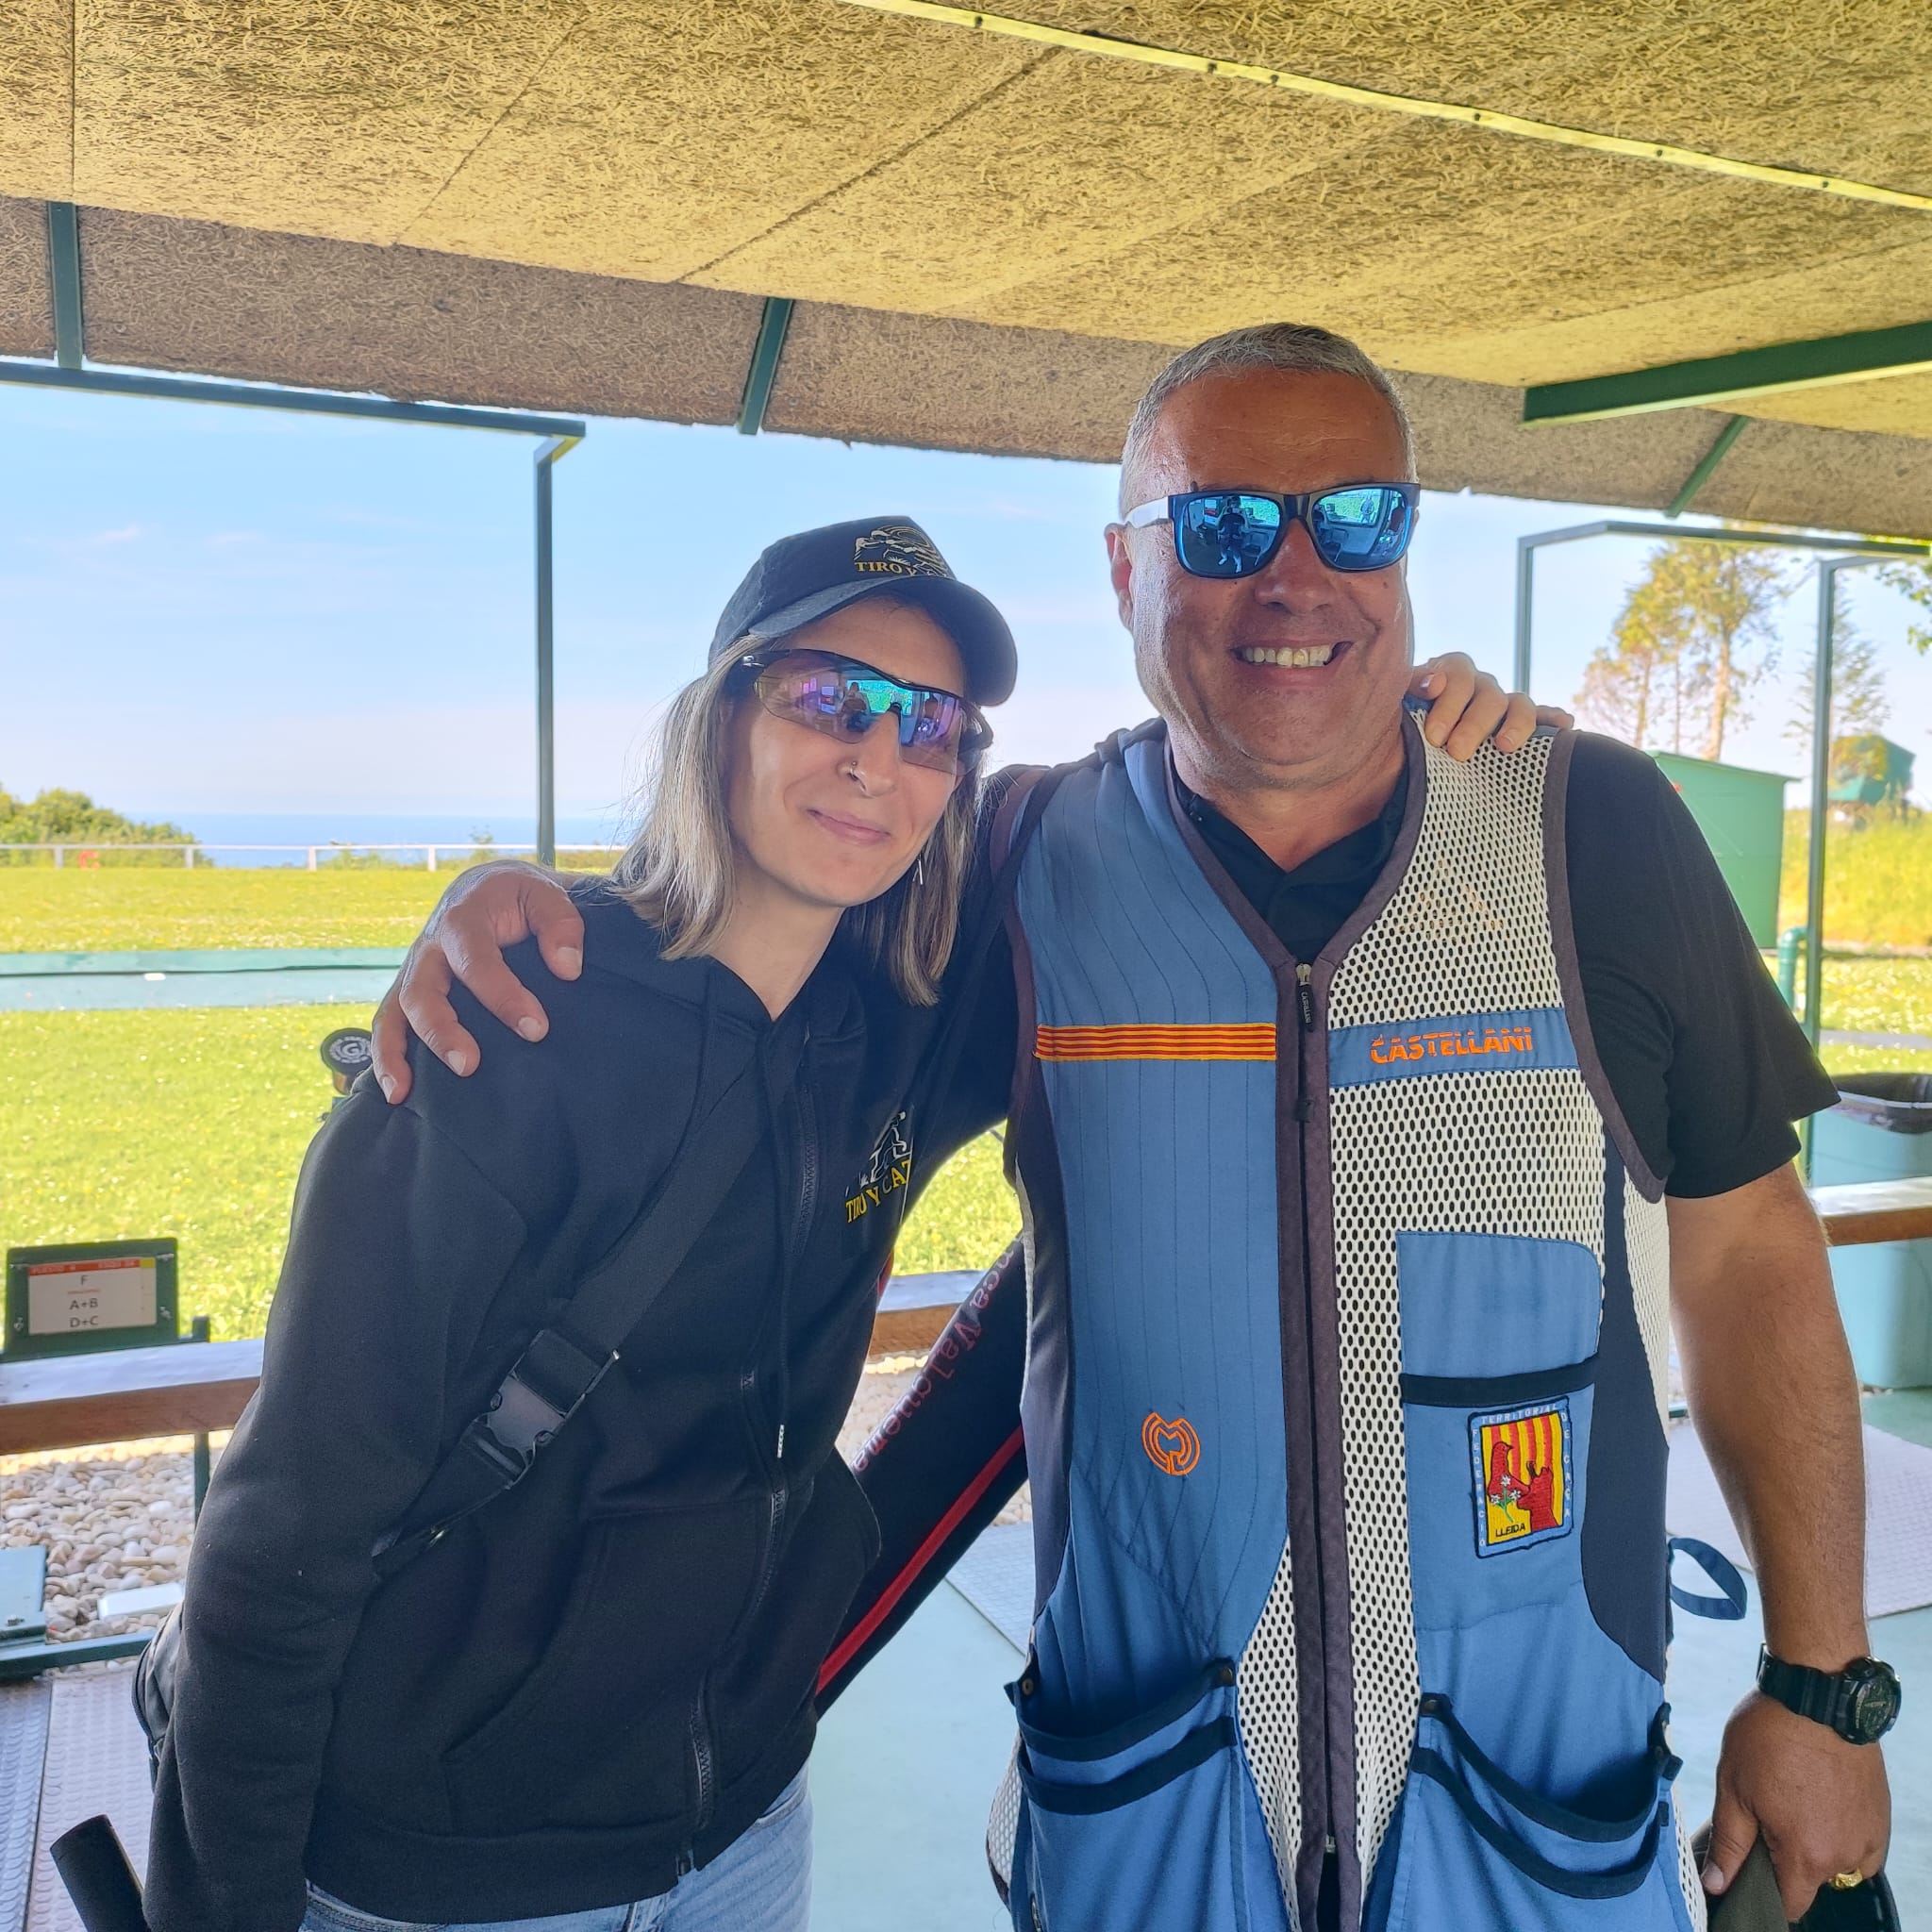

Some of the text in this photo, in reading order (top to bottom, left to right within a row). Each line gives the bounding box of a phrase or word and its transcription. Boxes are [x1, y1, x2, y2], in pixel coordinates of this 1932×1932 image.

[854, 561, 902, 574] TIRO
[1369, 1026, 1533, 1064] CASTELLANI
[866, 1185, 881, 1208] Y
[80, 1274, 90, 1285] F
[69, 1298, 99, 1311] A+B
[69, 1315, 99, 1328] D+C
[1481, 1404, 1558, 1424] TERRITORIAL
[1495, 1523, 1526, 1538] LLEIDA
